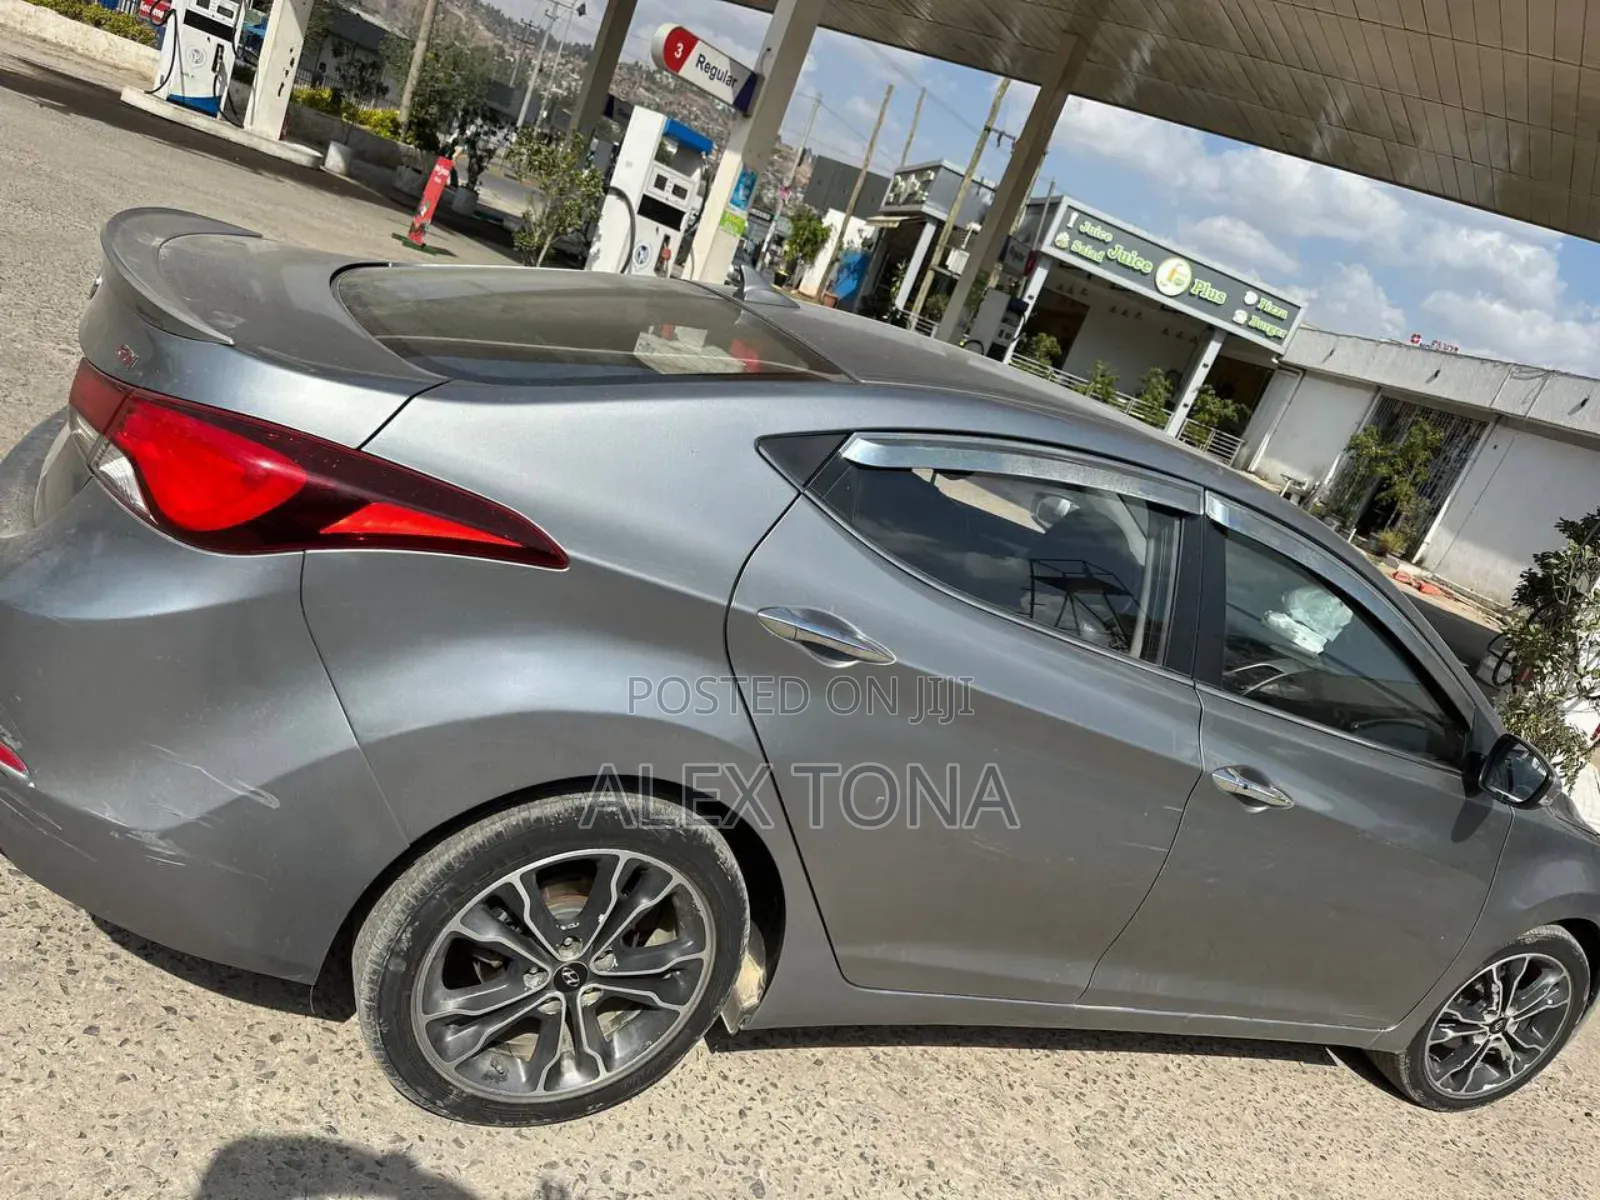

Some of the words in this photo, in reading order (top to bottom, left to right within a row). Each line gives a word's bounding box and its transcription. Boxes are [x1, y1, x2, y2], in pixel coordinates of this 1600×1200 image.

[674, 42, 684, 58] 3
[695, 53, 738, 88] Regular
[1080, 221, 1113, 242] Juice
[1071, 240, 1105, 262] Salad
[1107, 244, 1153, 273] Juice
[1191, 279, 1227, 304] Plus
